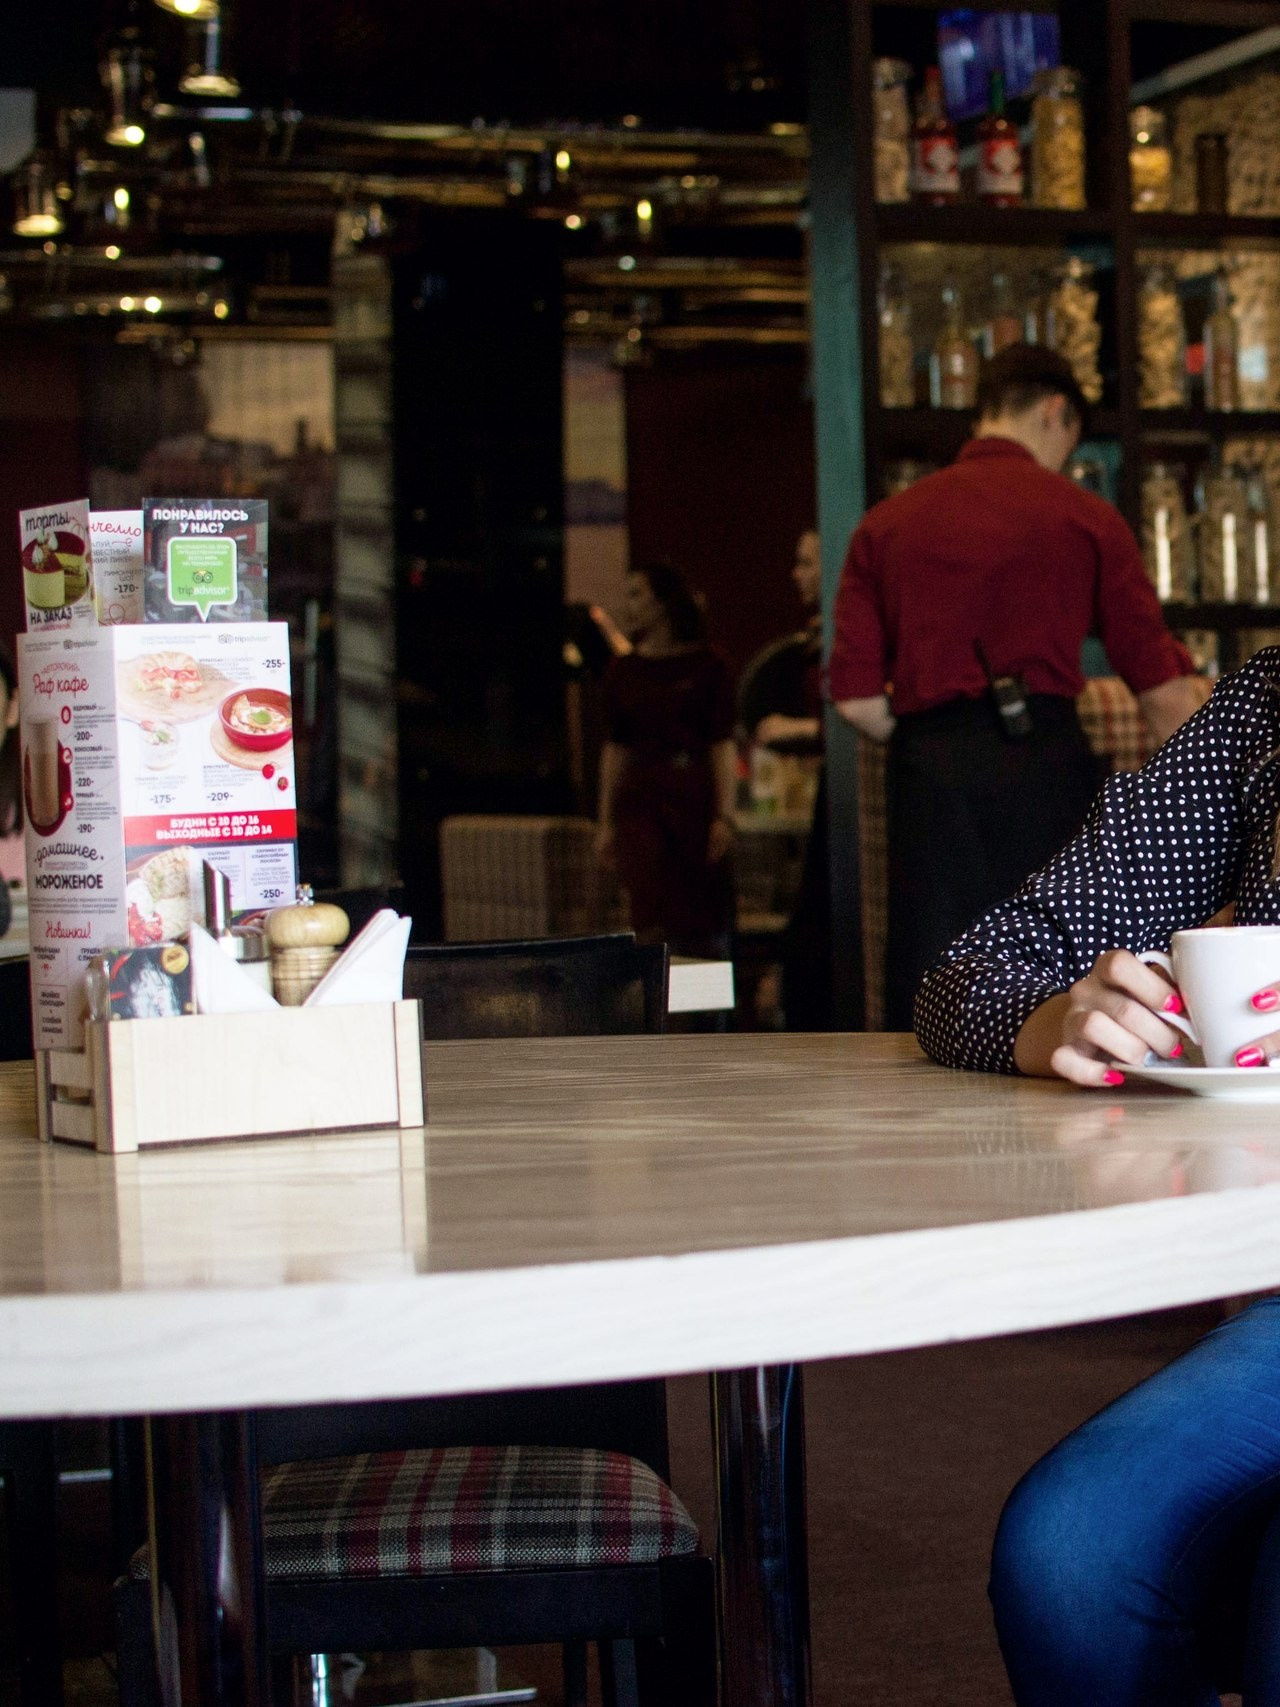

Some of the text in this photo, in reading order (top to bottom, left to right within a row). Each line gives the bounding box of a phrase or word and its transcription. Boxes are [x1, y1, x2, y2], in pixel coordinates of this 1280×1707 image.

[152, 508, 249, 521] ПОНРАВИЛОСЬ
[25, 511, 70, 535] торты
[180, 522, 225, 534] У НАС?
[178, 586, 228, 597] tripadvisor
[30, 610, 43, 625] НА
[44, 607, 73, 622] ЗАКАЗ
[57, 676, 90, 698] кафе
[170, 817, 206, 829] БУДНИ
[208, 817, 217, 826] С
[231, 815, 247, 827] ДО
[156, 827, 221, 840] ВЫХОДНЫЕ
[222, 826, 231, 837] С
[245, 825, 261, 837] ДО
[35, 873, 104, 889] МОРОЖЕНОЕ
[45, 920, 91, 939] Новинки!
